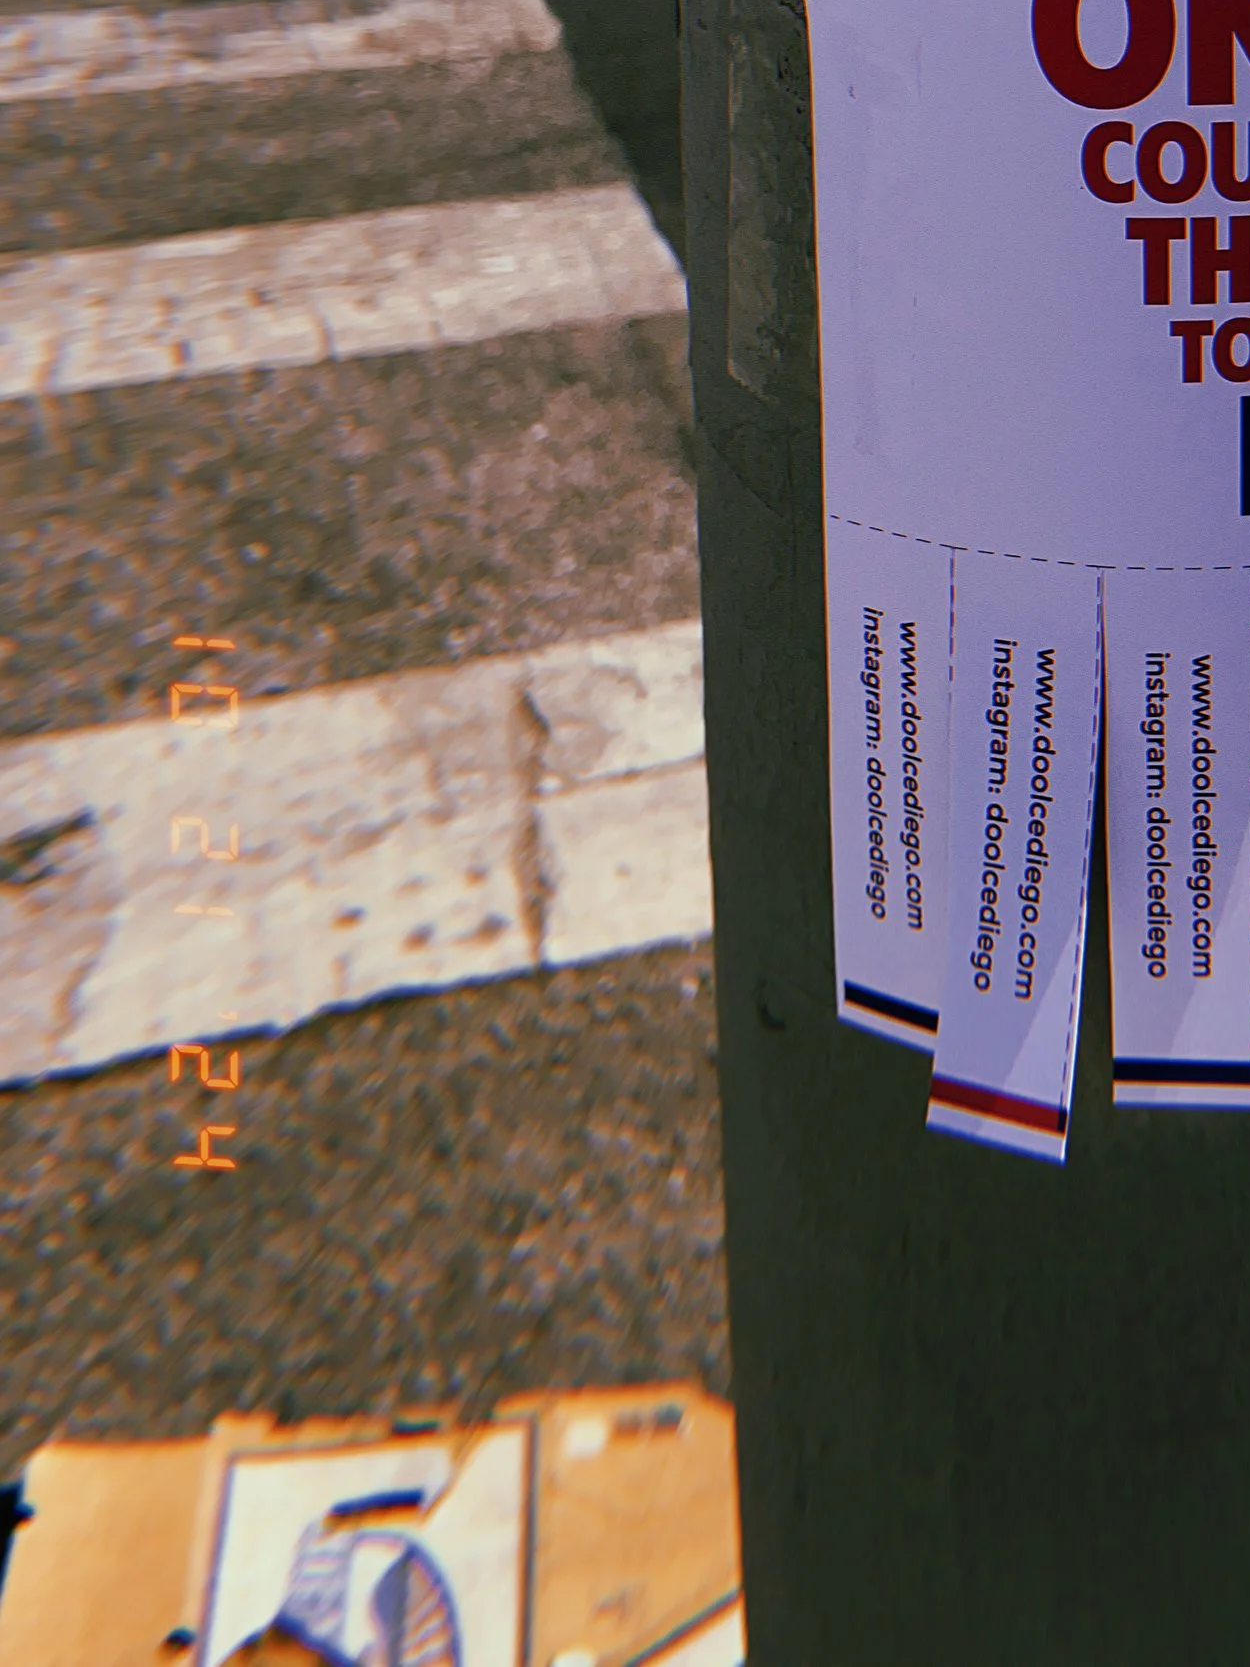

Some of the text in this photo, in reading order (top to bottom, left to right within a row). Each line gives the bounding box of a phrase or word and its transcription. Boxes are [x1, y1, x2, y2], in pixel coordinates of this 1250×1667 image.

[860, 607, 888, 920] instagram: doolcediego
[899, 622, 923, 930] www.doolcediego.com
[970, 638, 1019, 992] instagram: doolcediego
[1012, 648, 1054, 1000] www.doolcediego.com
[1140, 652, 1172, 979] instagram: doolcediego
[1186, 654, 1217, 978] www.doolcediego.com
